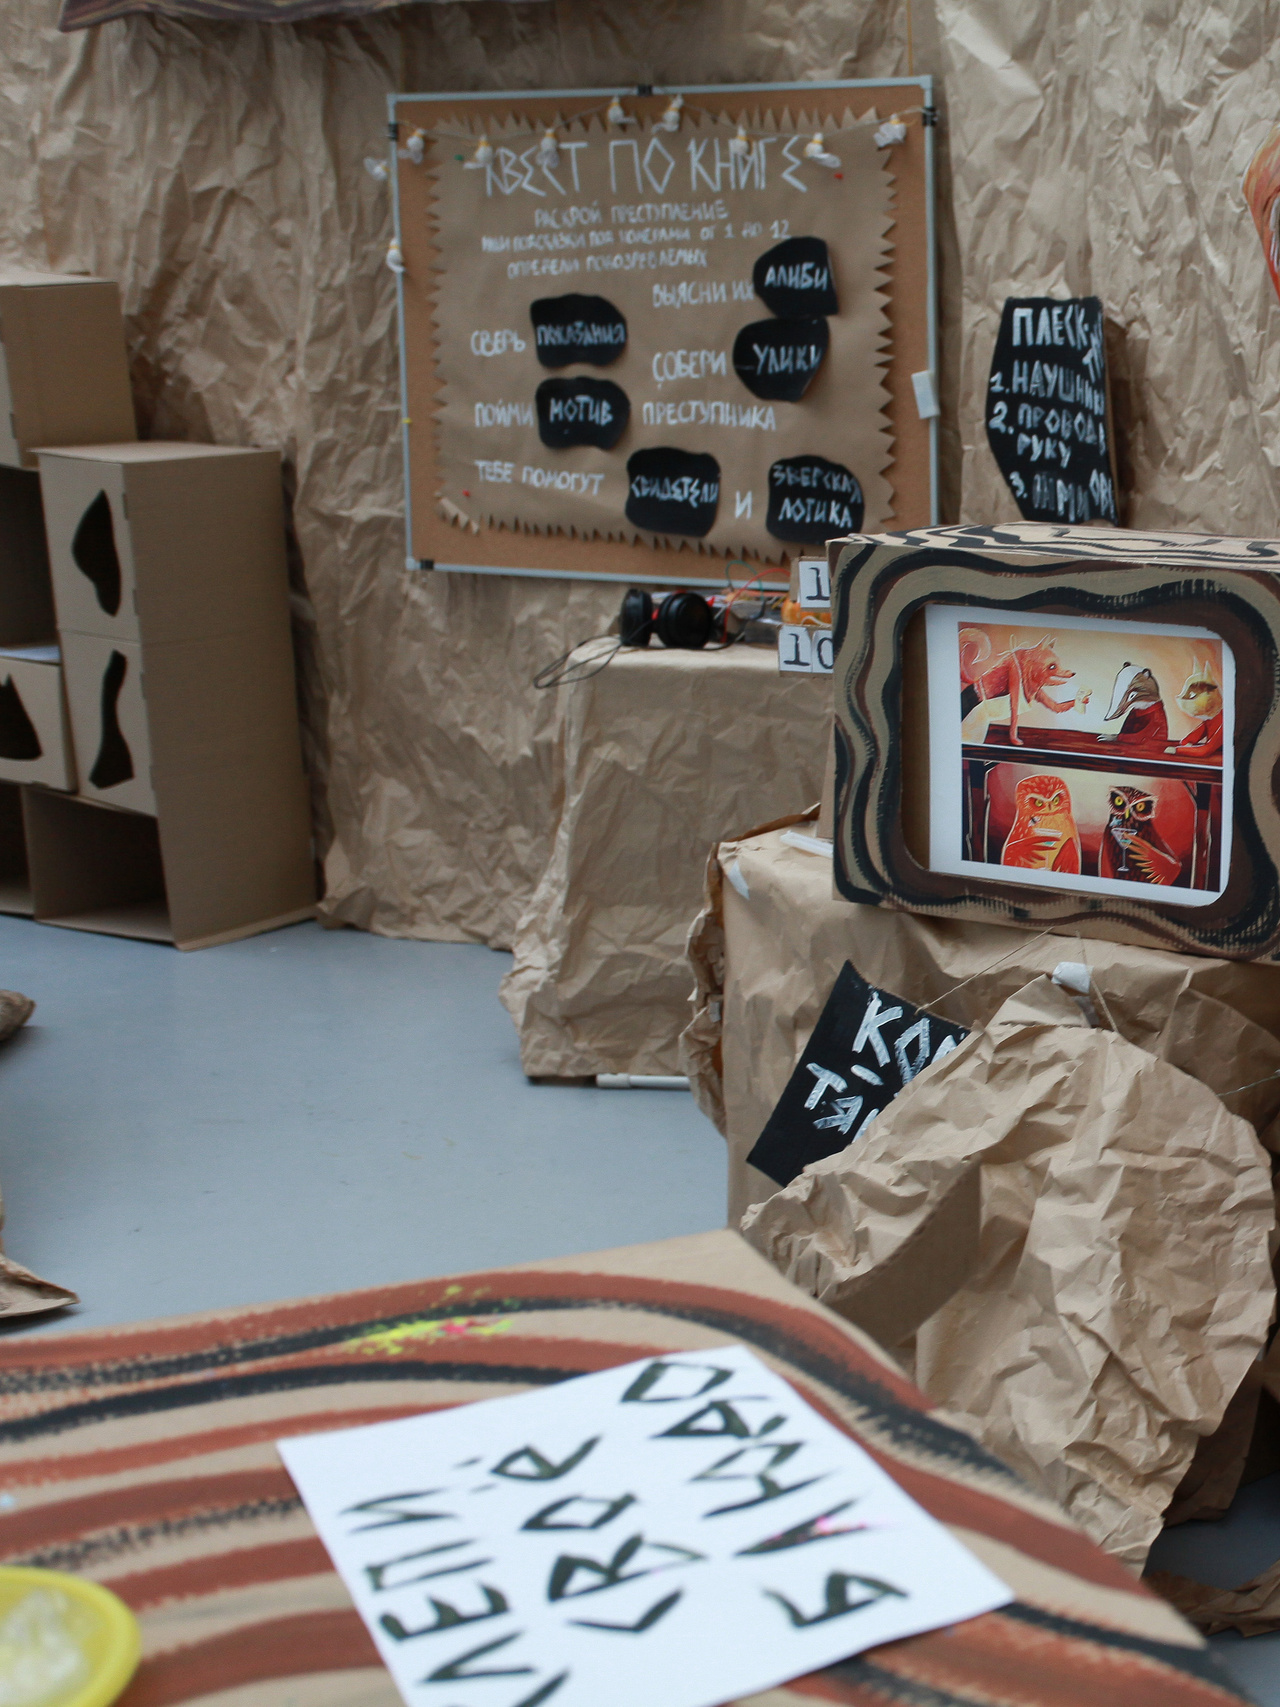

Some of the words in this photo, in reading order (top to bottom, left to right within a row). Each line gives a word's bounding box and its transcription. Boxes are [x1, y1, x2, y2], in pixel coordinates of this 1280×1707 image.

[609, 137, 676, 195] ПО
[686, 134, 808, 193] КНИГЕ
[724, 222, 735, 239] 1
[769, 218, 792, 240] 12
[652, 280, 727, 309] ВЫЯСНИ
[764, 260, 829, 292] АЛИБИ
[470, 328, 526, 357] СВЕРЬ
[652, 349, 727, 384] СОБЕРИ
[753, 342, 822, 376] УЛИКИ
[474, 398, 534, 428] ПОЙМИ
[550, 394, 613, 427] МОТИВ
[642, 400, 777, 432] ПРЕСТУПНИКА
[1016, 432, 1071, 468] РУКУ
[474, 459, 516, 484] ТЕБЕ
[521, 464, 605, 496] ПОМОГУТ
[734, 490, 752, 520] И
